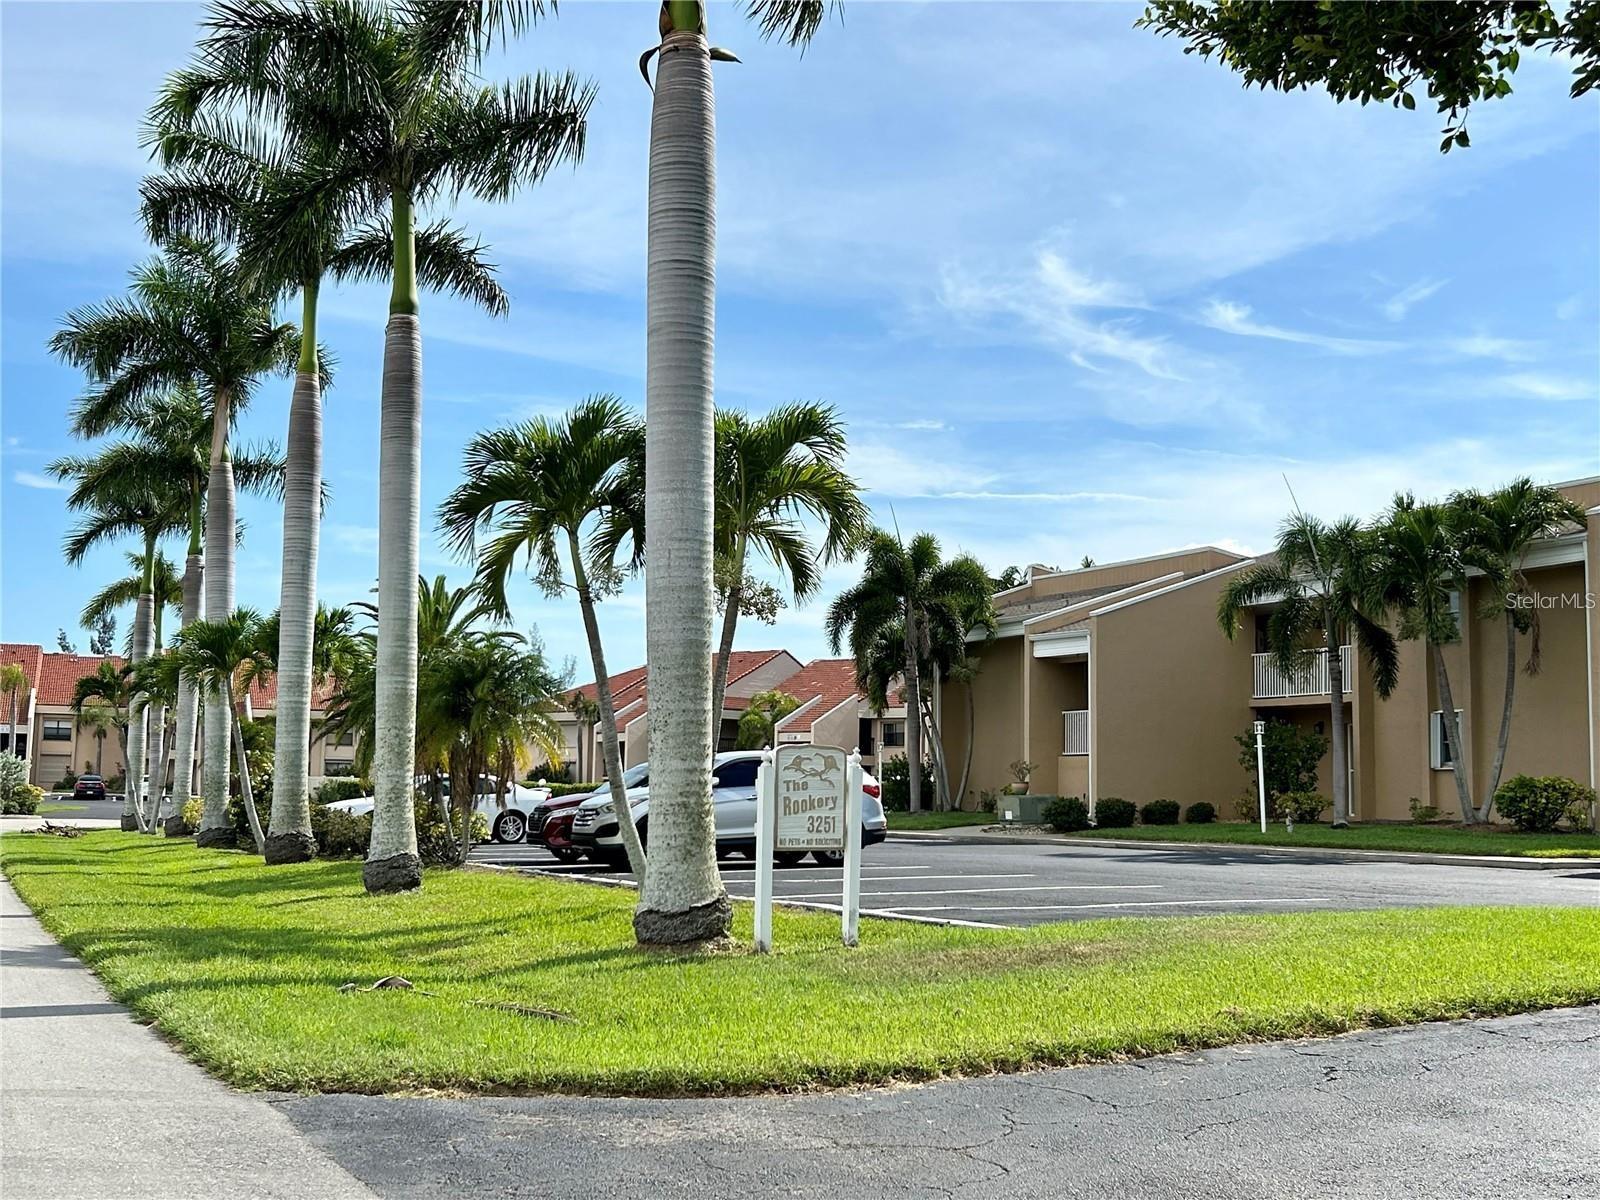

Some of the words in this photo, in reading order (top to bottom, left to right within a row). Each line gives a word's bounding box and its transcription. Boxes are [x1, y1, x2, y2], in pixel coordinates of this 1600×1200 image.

[783, 780, 808, 792] The
[783, 795, 838, 816] Rookery
[807, 815, 836, 833] 3251
